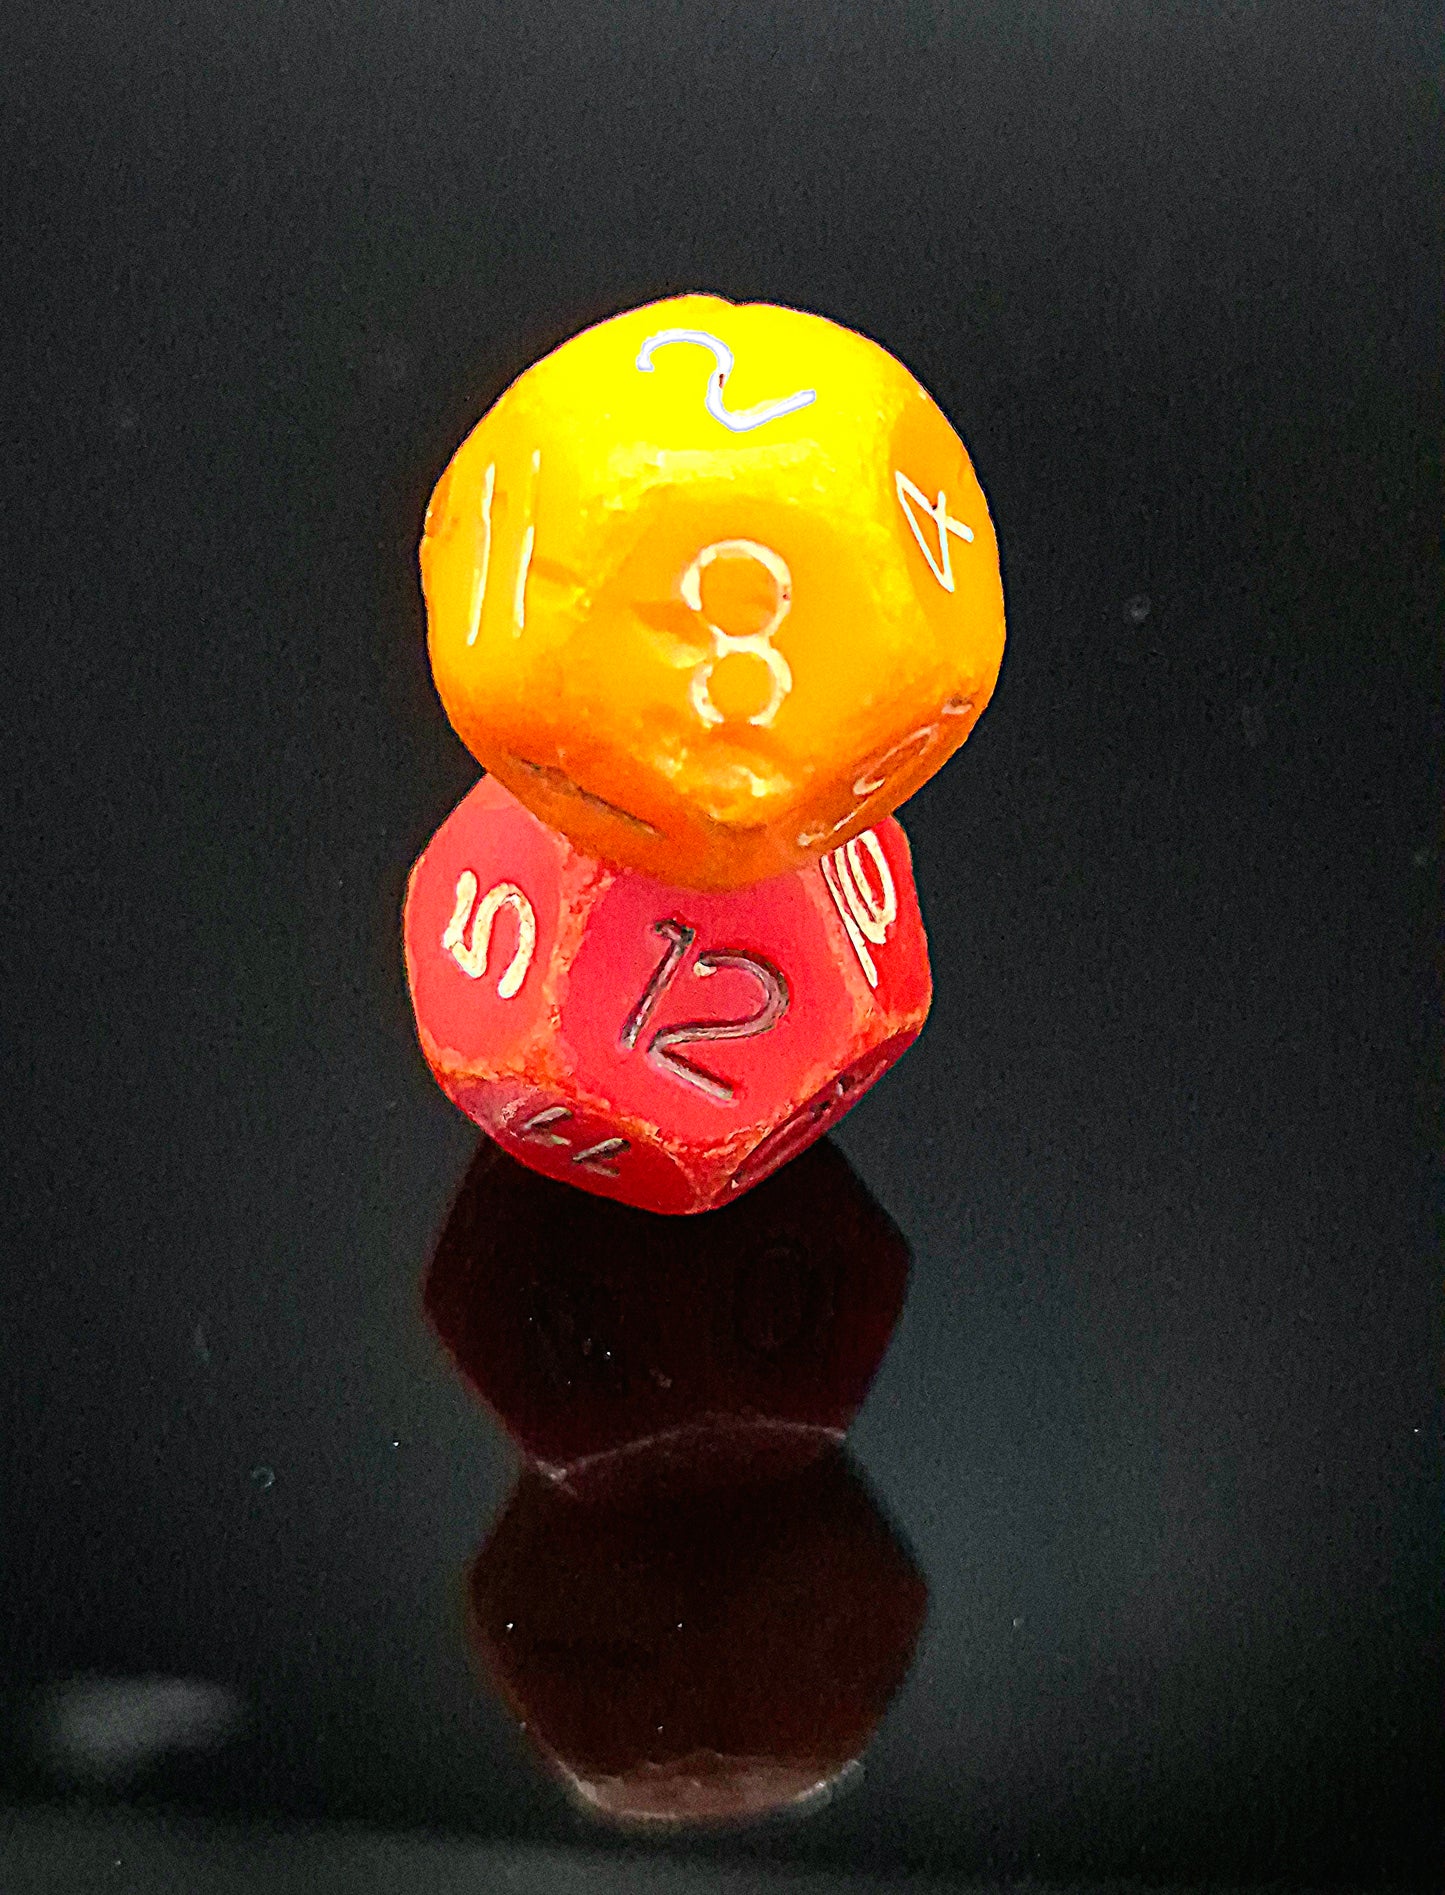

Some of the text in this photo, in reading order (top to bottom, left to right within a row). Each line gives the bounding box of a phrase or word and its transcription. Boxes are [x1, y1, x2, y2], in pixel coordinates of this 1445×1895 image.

[636, 329, 817, 432] 2
[467, 449, 541, 647] 11
[895, 469, 976, 593] 4
[681, 538, 794, 727] 8
[442, 870, 536, 999] 5
[619, 914, 792, 1103] 12
